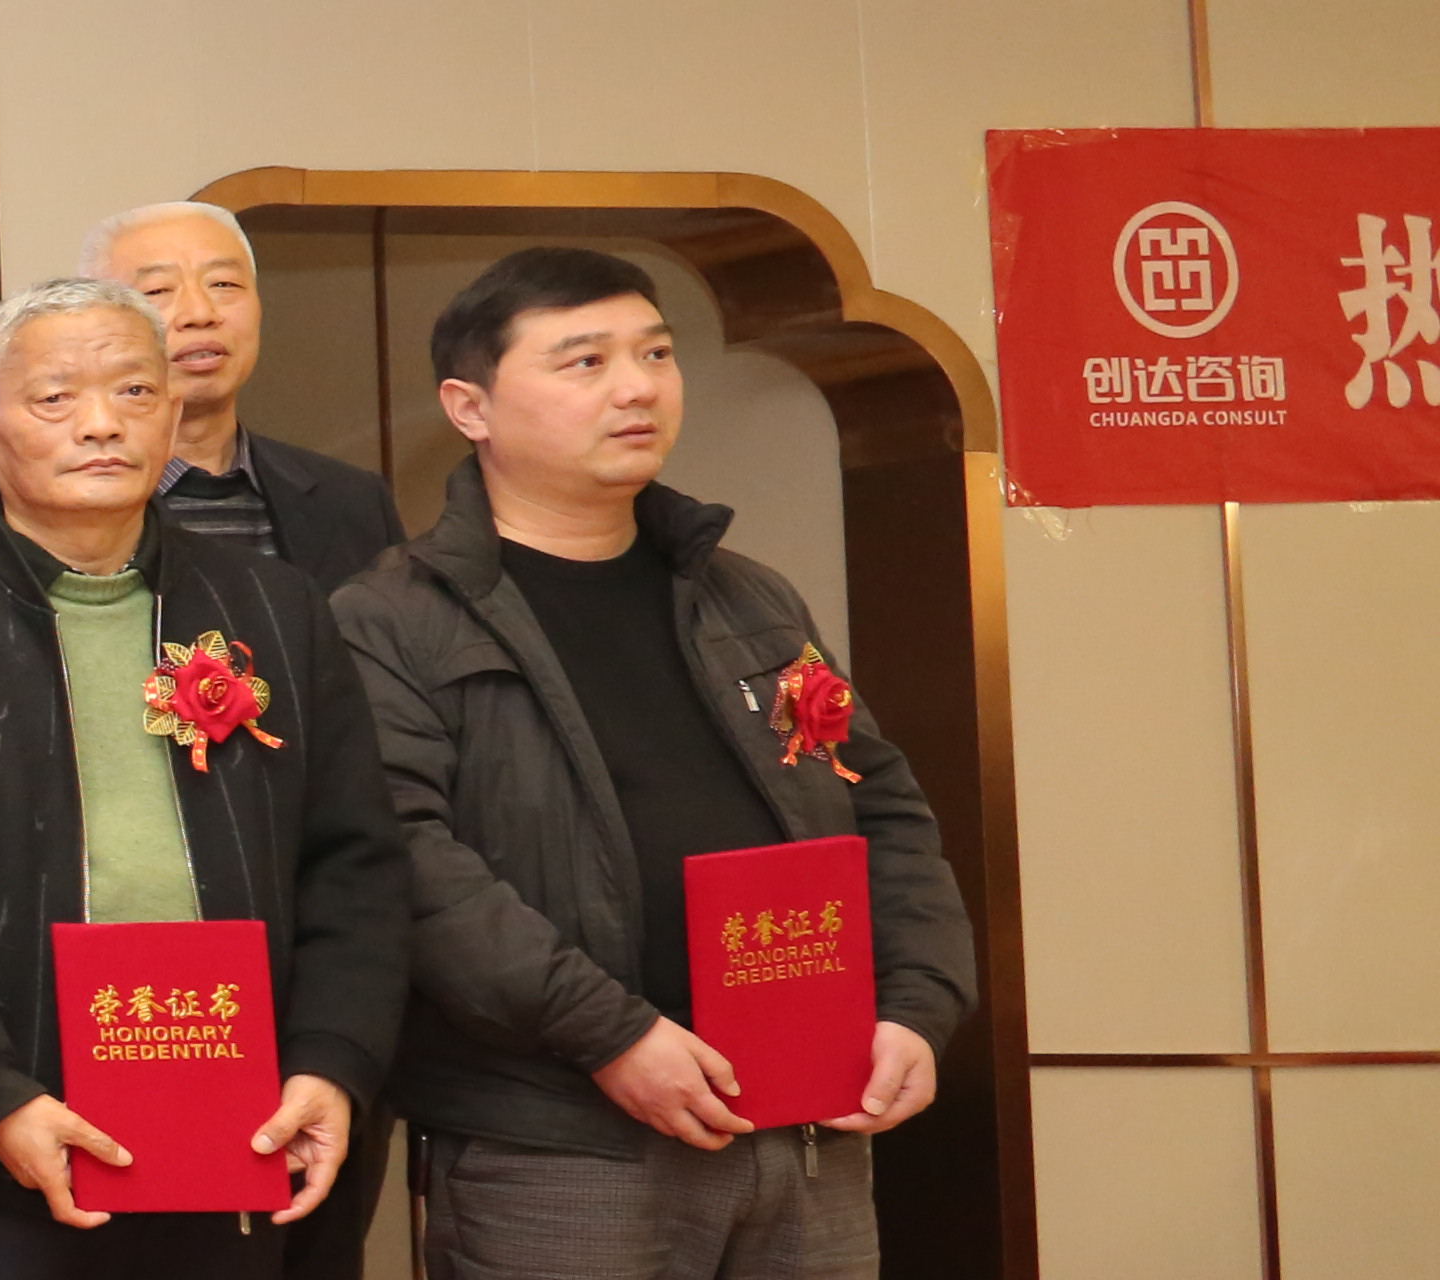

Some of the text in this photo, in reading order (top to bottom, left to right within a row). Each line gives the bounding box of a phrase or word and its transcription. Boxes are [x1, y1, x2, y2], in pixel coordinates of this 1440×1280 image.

[1338, 213, 1440, 409] 热
[1082, 355, 1287, 404] 创达咨询
[1089, 410, 1287, 428] CHUANGDA CONSULT
[720, 900, 844, 951] 荣誉证书
[729, 941, 838, 968] HONORARY
[722, 957, 847, 988] CREDENTIAL
[89, 983, 241, 1025] 荣誉证书
[100, 1025, 233, 1043] HONORARY
[92, 1043, 245, 1061] CREDENTIAL
